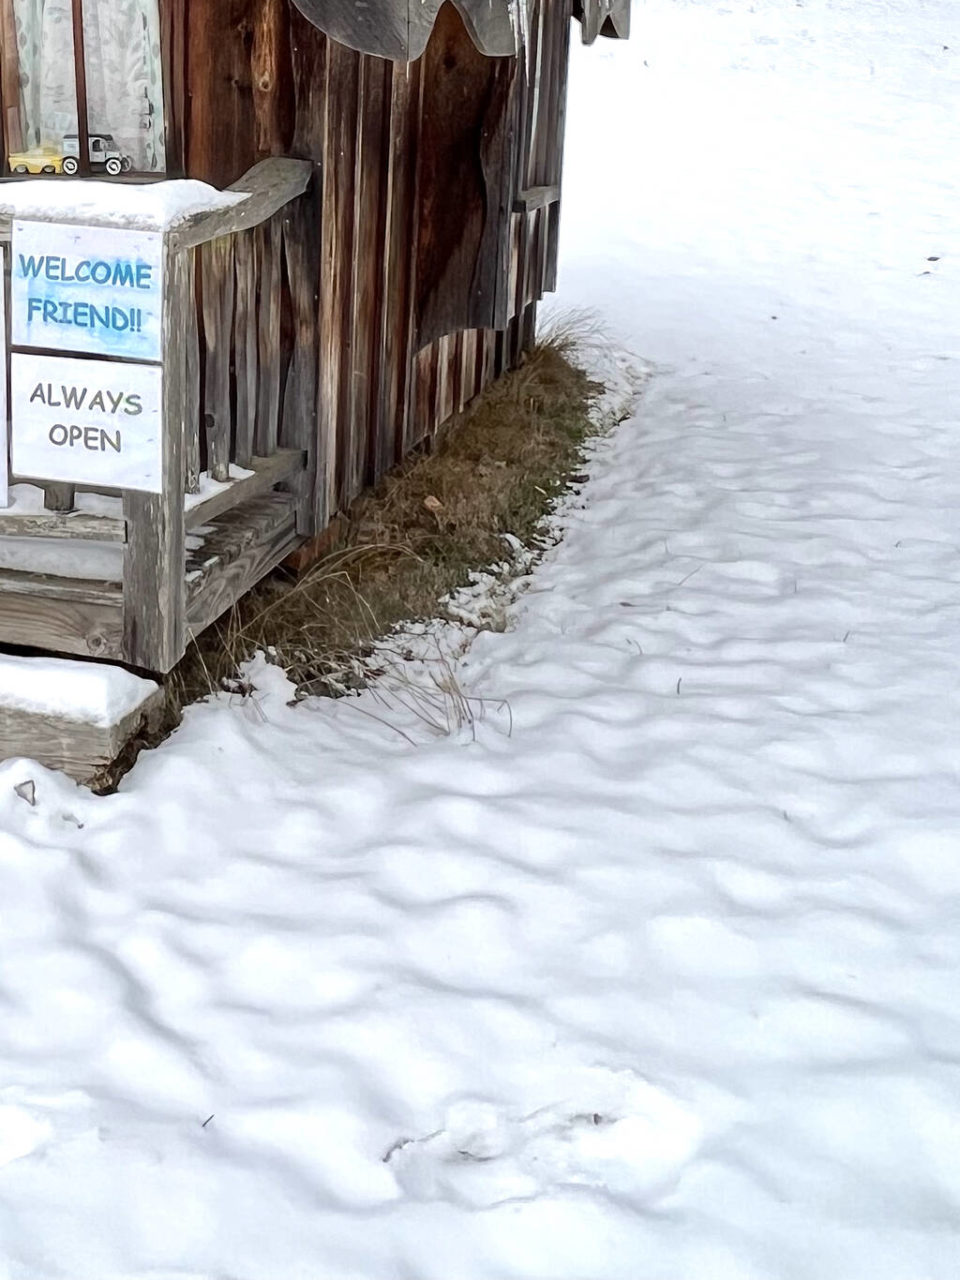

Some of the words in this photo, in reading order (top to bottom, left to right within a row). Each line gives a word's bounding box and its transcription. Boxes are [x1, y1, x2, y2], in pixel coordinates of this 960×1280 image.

[19, 254, 153, 290] WELCOME
[27, 297, 142, 332] FRIEND!!
[29, 382, 143, 416] ALWAYS
[48, 424, 122, 453] OPEN
